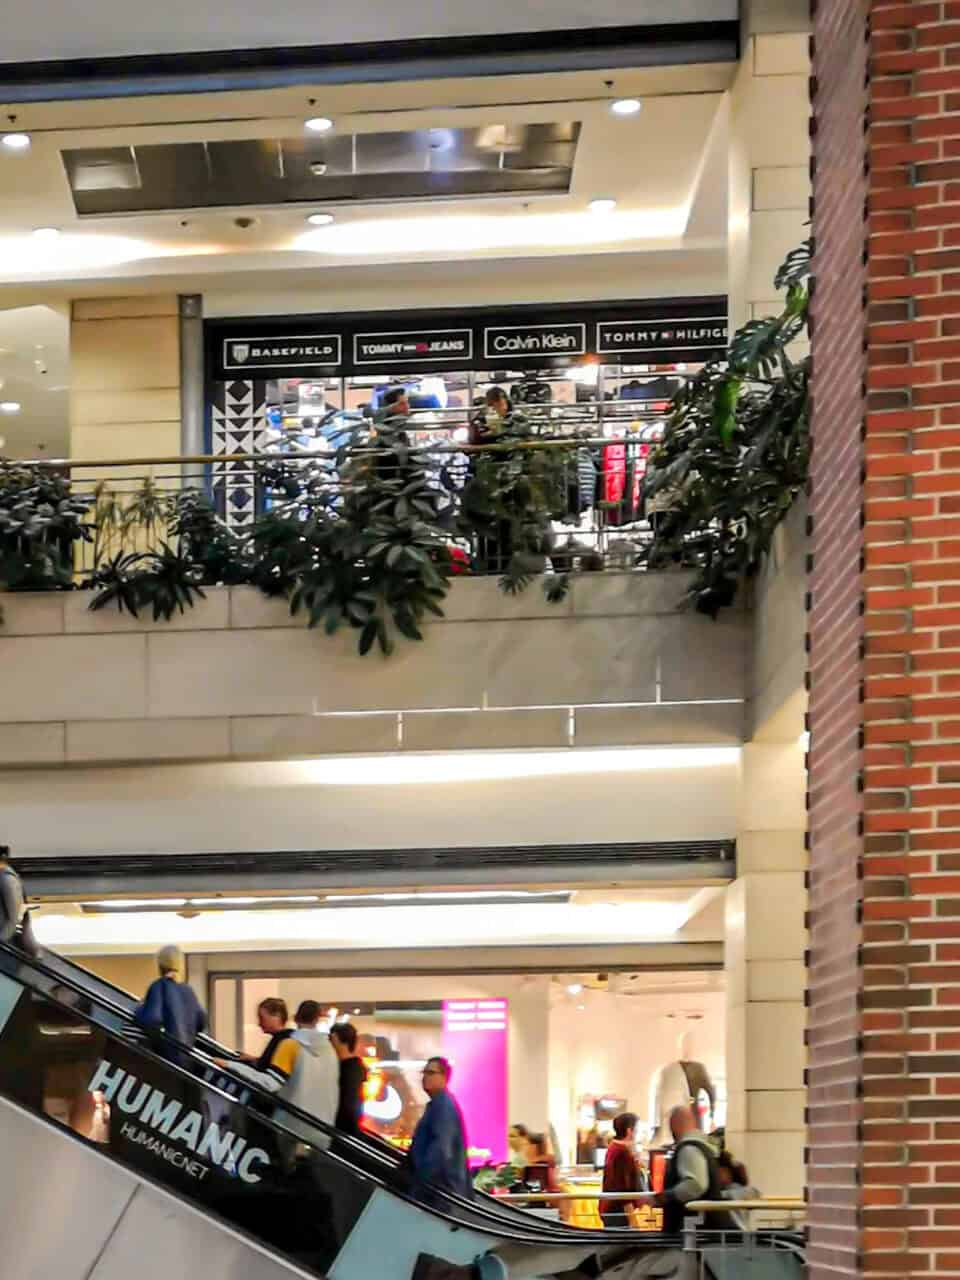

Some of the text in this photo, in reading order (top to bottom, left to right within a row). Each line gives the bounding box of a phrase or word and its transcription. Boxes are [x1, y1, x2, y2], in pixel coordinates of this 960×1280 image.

[494, 332, 576, 352] Calvin Klein
[604, 332, 660, 343] TOMMY
[251, 345, 333, 358] BASEFIELD
[361, 340, 465, 355] TOMMY JEANS
[87, 1059, 271, 1184] HUMANIC
